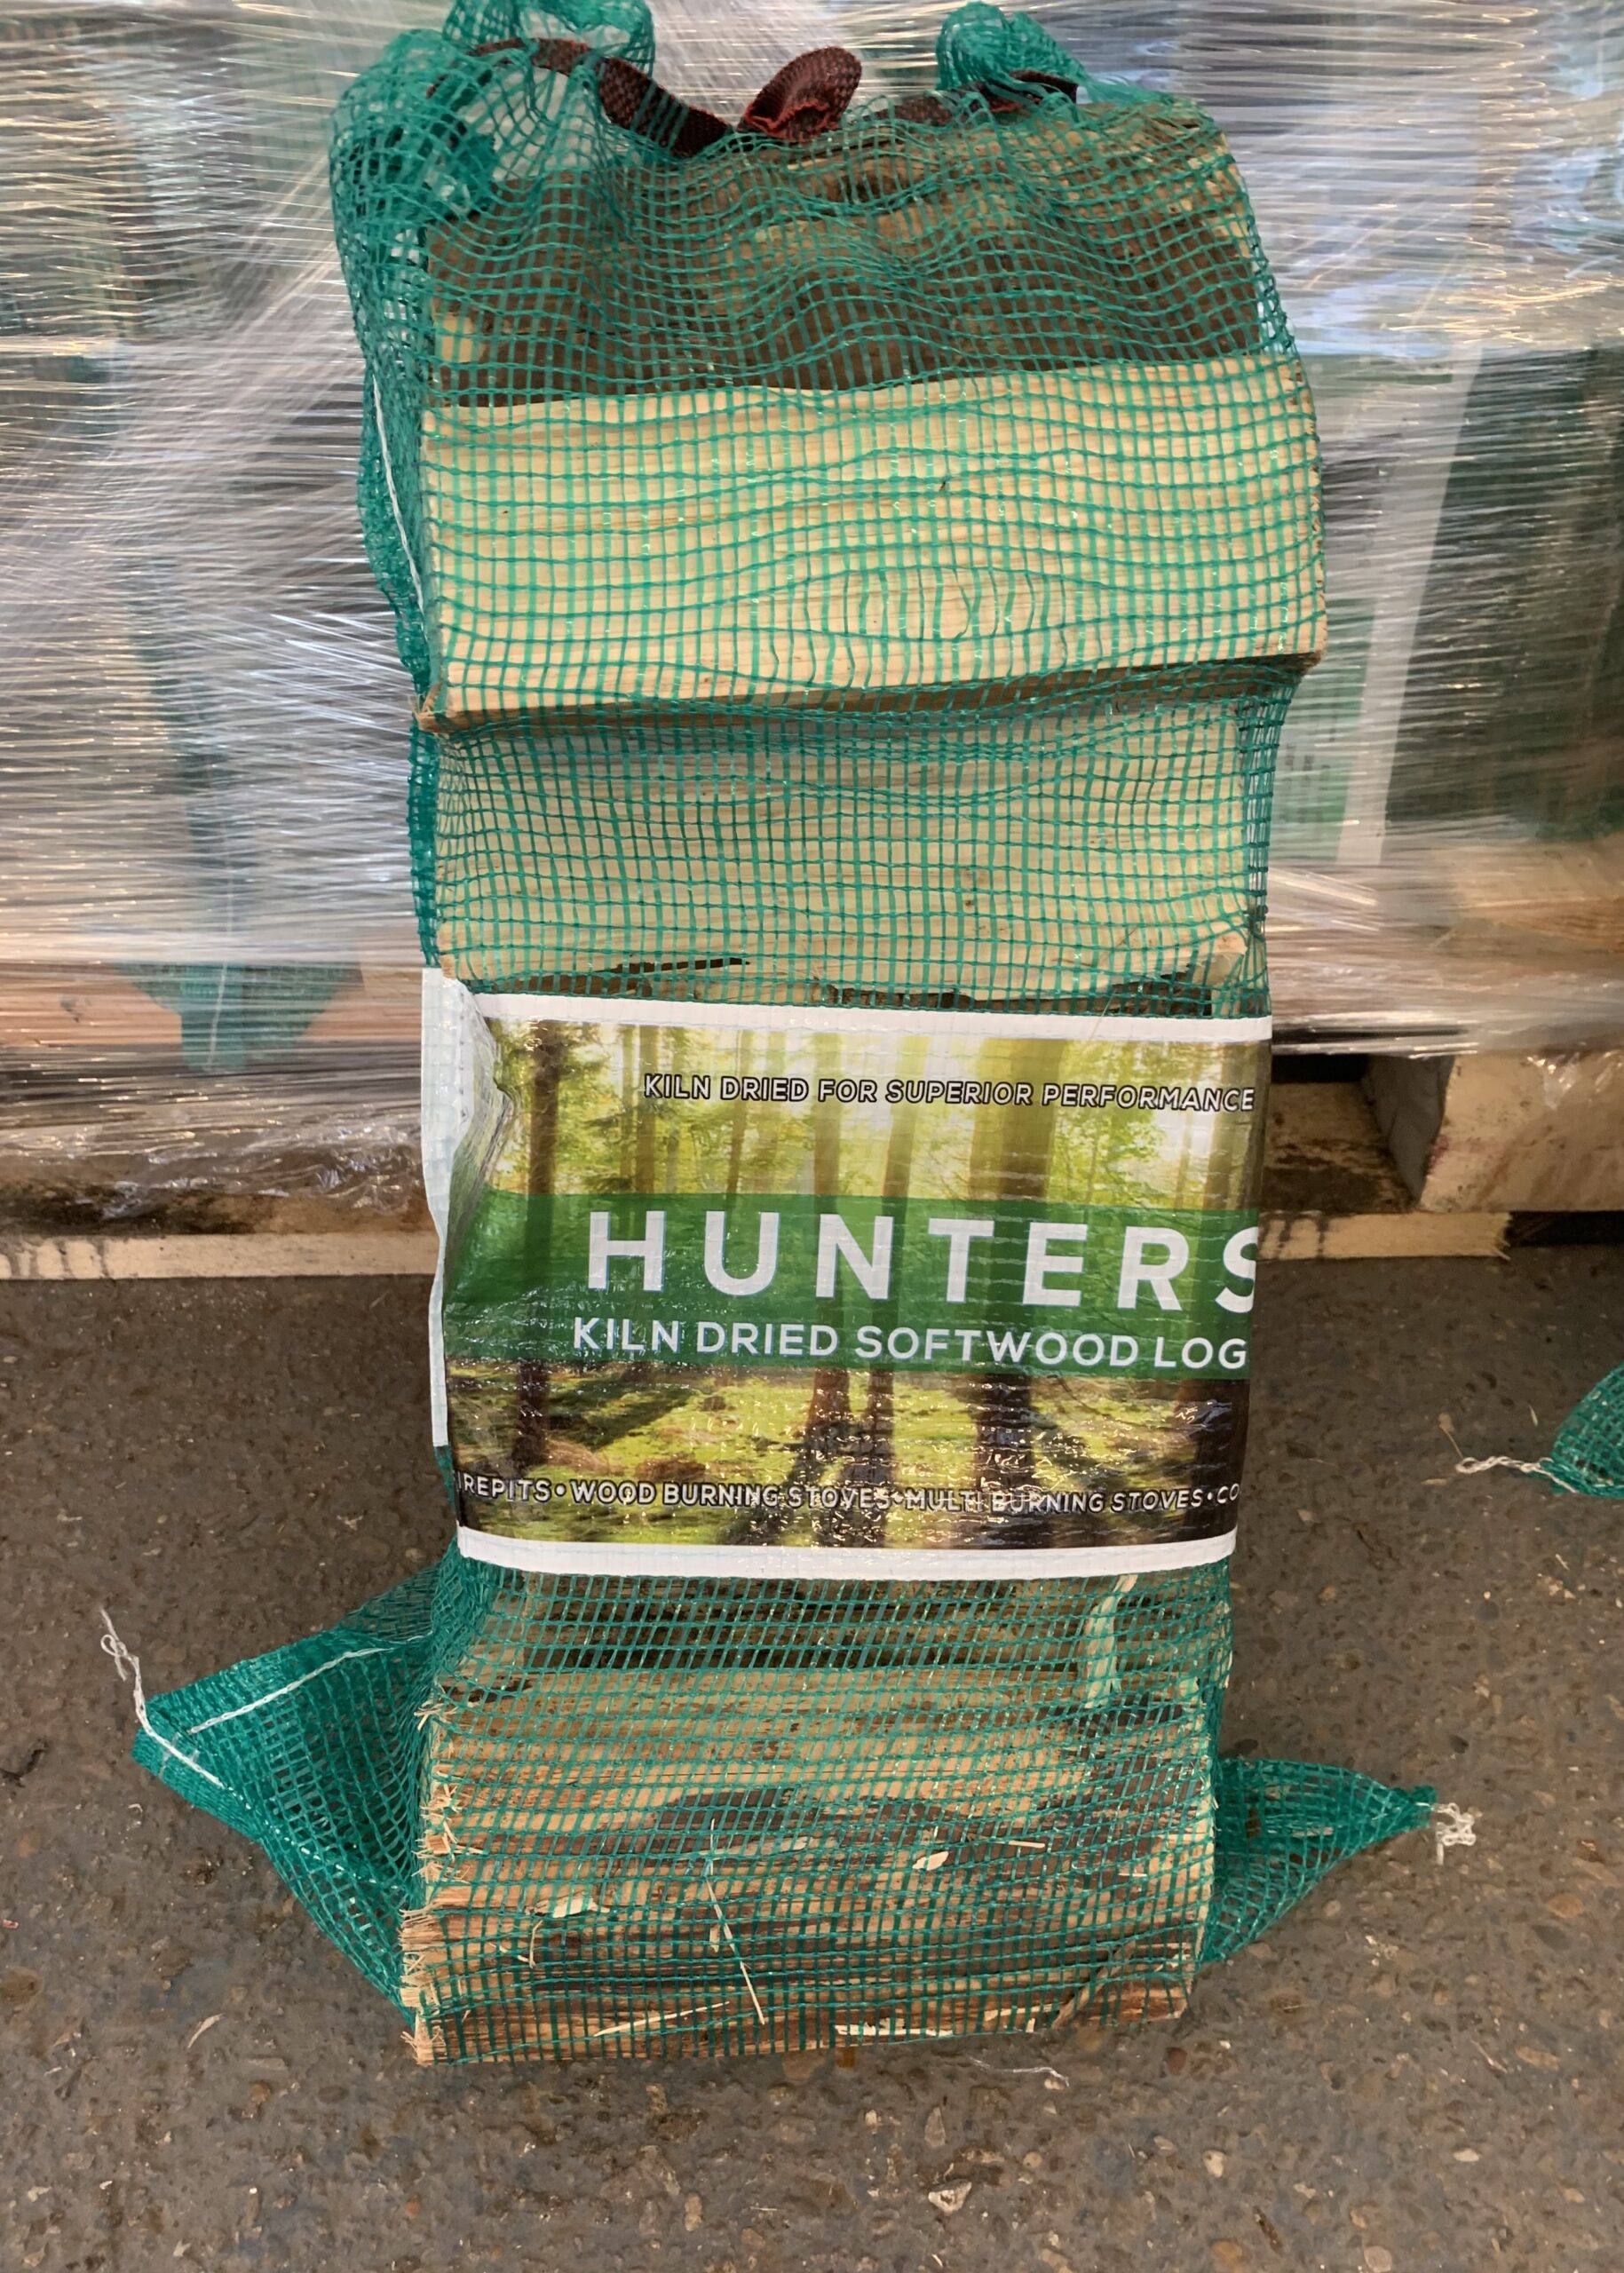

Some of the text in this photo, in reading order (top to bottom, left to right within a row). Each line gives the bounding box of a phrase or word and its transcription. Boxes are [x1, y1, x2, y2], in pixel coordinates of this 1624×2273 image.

[645, 1073, 1255, 1113] KILN DRIED FOR SUPERIOR PERFORMANCE
[588, 1211, 1258, 1314] HUNTERS
[574, 1317, 680, 1353] KILN
[697, 1322, 839, 1357] DRIED
[854, 1325, 1138, 1367] SOFTWOOD
[571, 1478, 656, 1506] WOOD
[663, 1481, 780, 1509] BURNING
[787, 1485, 890, 1510] STOVES
[905, 1486, 984, 1512] MULTI
[991, 1491, 1105, 1514] BURNING
[1110, 1487, 1204, 1513] STOVES
